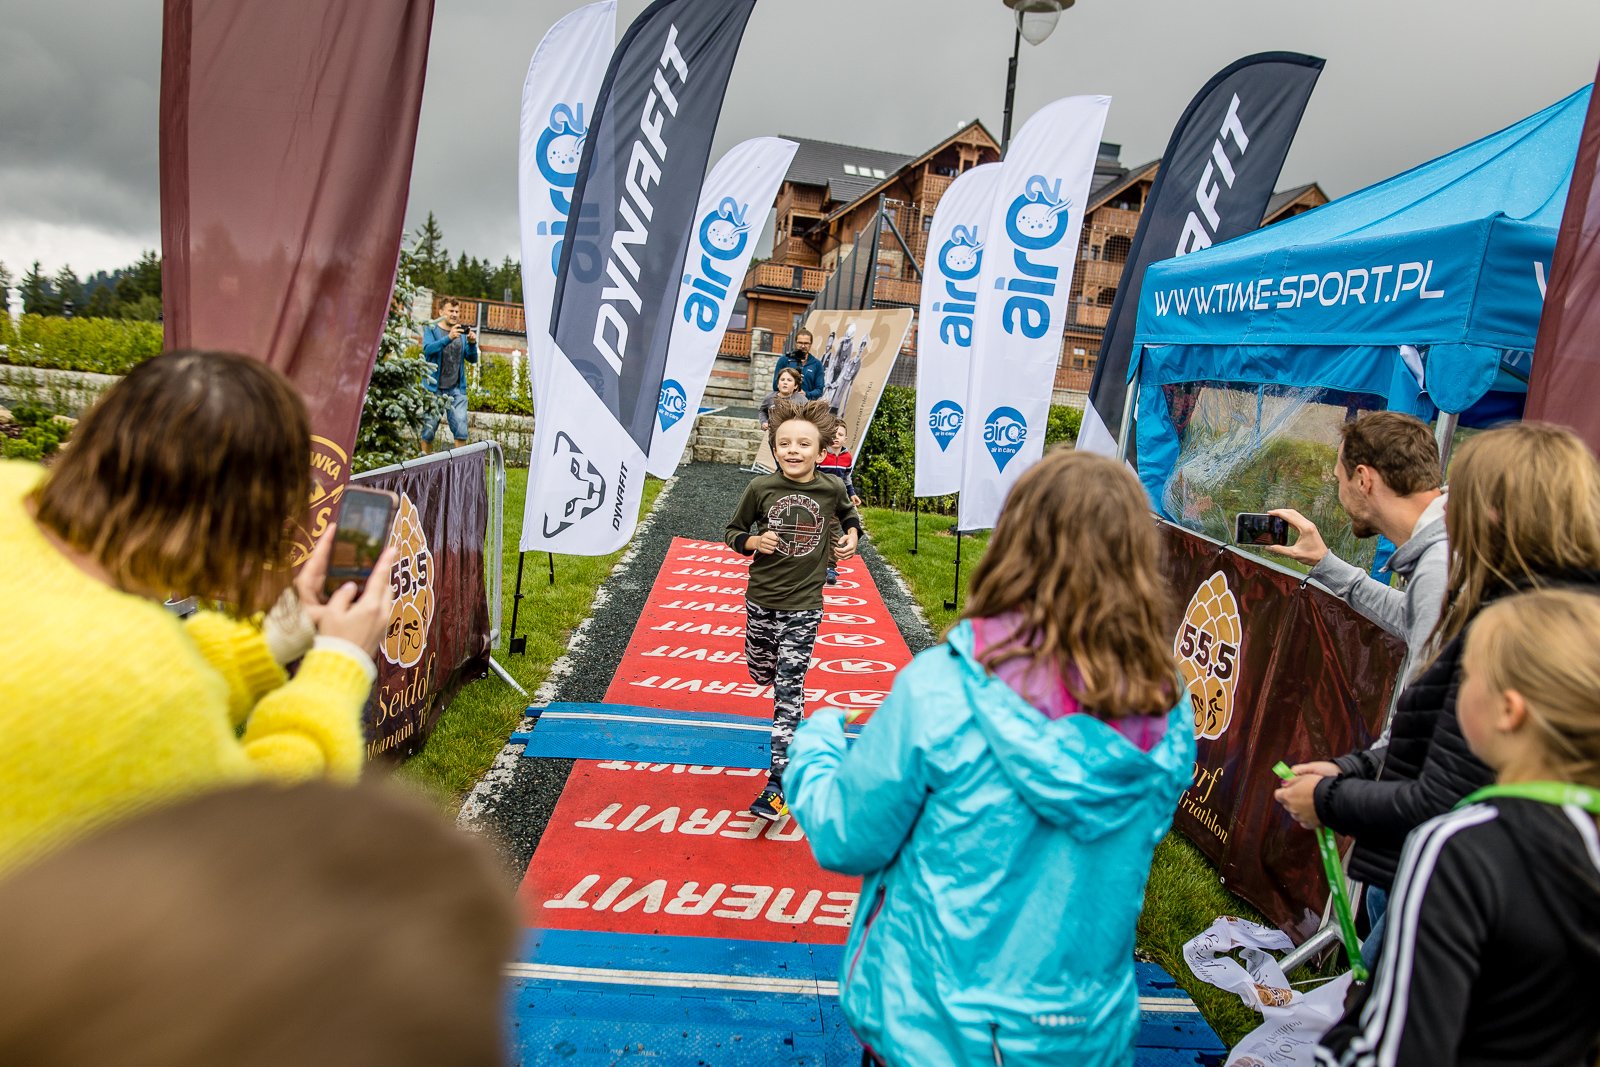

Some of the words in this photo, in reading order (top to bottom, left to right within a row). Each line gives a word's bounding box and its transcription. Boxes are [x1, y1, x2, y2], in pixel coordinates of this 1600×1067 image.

[593, 23, 688, 377] DYNAFIT
[1175, 93, 1250, 258] AFIT
[1154, 260, 1445, 317] WWW.TIME-SPORT.PL
[611, 461, 629, 532] DYNAFIT
[390, 551, 428, 601] 55,5
[1180, 622, 1236, 680] 55,5
